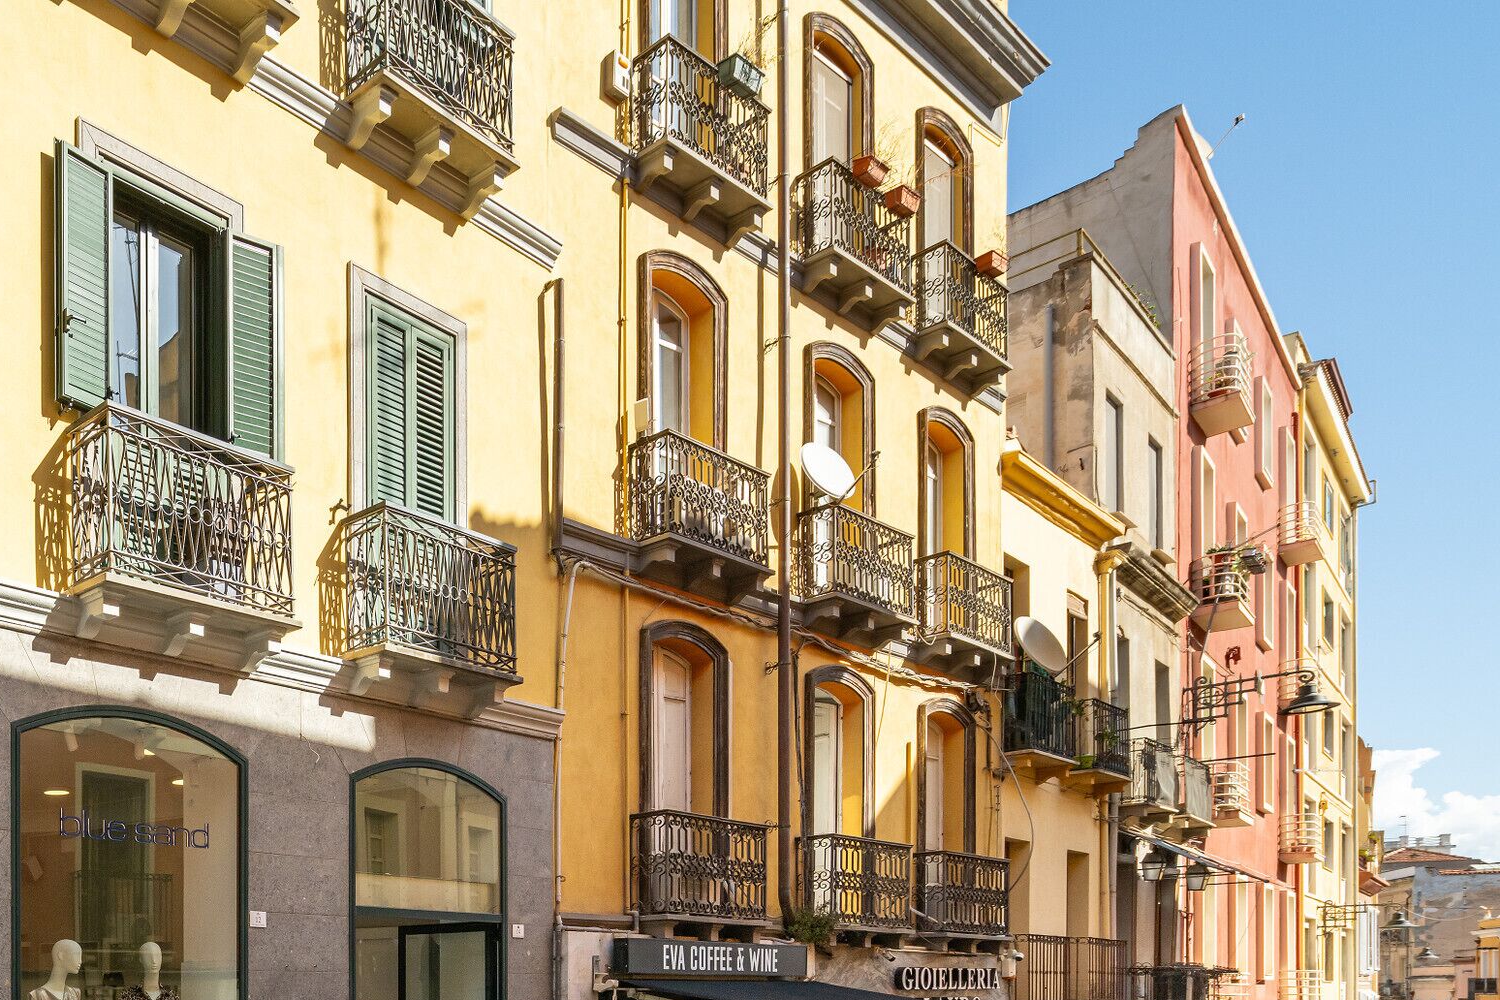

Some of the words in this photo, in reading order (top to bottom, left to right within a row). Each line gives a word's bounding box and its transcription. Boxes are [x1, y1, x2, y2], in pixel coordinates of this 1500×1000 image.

[59, 807, 126, 842] blue
[134, 822, 210, 849] sand
[663, 944, 686, 971] EVA
[690, 946, 733, 972] COFFEE
[737, 947, 745, 972] &
[749, 948, 778, 973] WINE
[902, 967, 1000, 990] GIOIELLERIA
